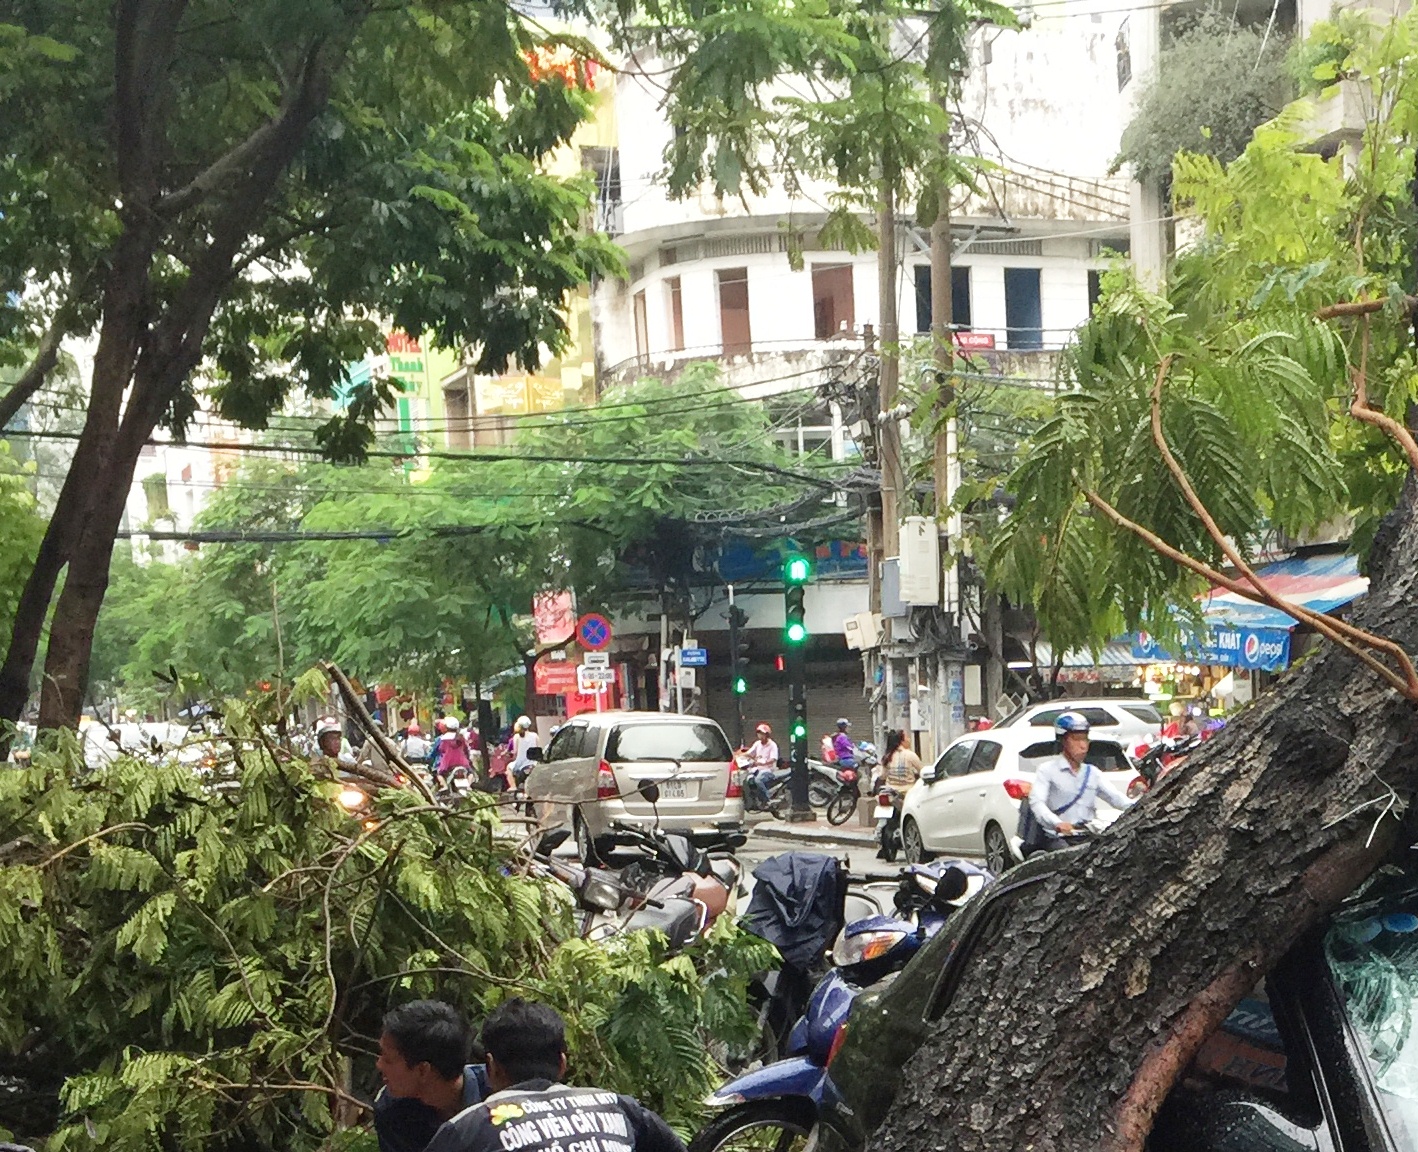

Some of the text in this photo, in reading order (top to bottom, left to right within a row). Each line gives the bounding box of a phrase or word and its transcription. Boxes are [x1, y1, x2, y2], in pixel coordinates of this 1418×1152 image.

[1258, 638, 1286, 657] pepsi
[551, 1096, 567, 1110] TY
[499, 1121, 542, 1152] CÔNG
[536, 1112, 575, 1140] VIÊN
[570, 1109, 601, 1135] CÂY
